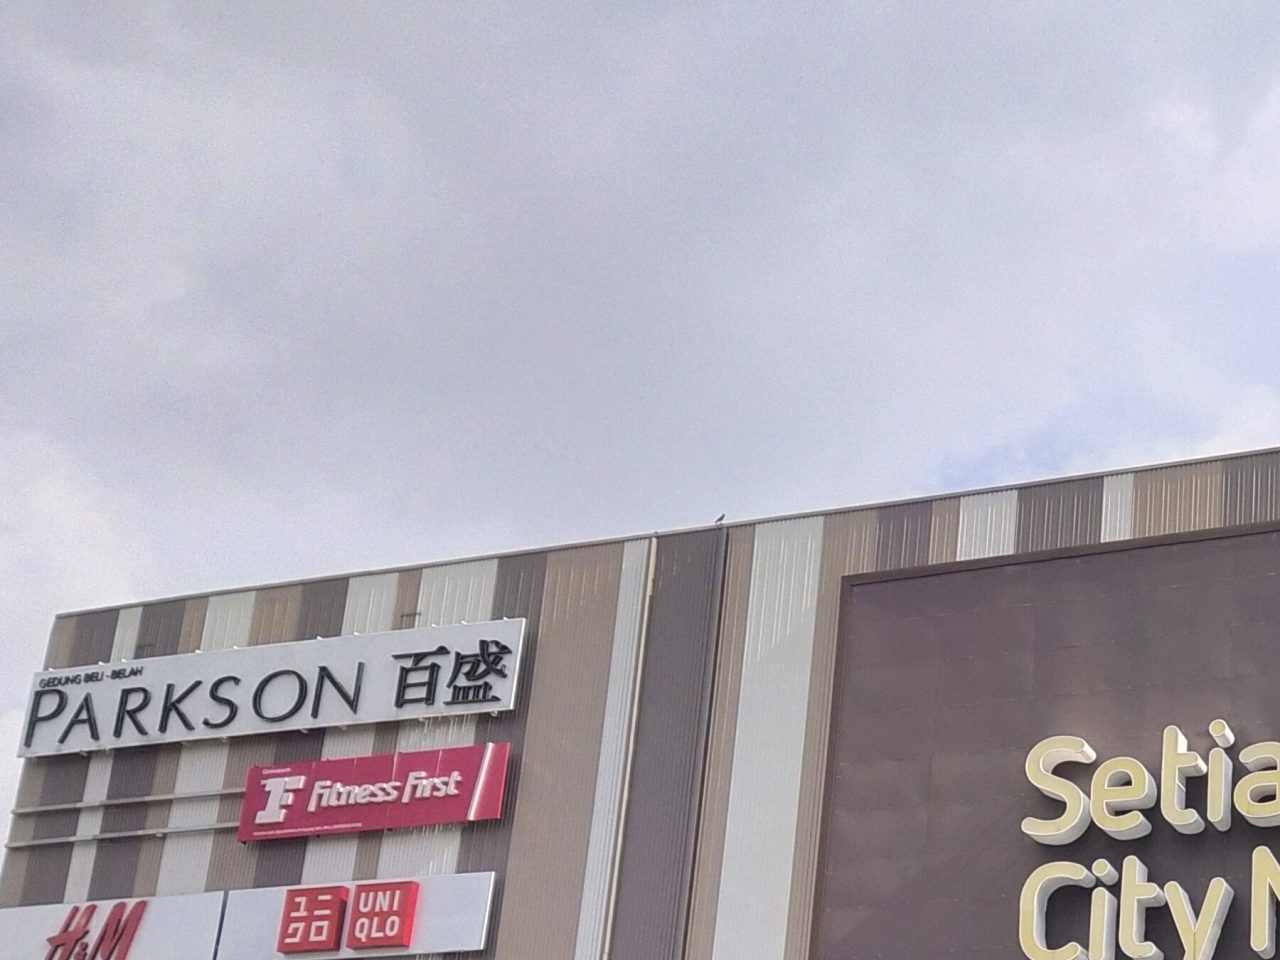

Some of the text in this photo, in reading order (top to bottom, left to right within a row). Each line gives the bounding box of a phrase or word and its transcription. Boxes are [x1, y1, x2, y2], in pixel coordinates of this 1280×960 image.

[39, 673, 82, 688] GEDUNG
[391, 638, 513, 709] 百盛
[23, 661, 365, 747] PARKSON
[307, 770, 462, 813] Fitness First
[358, 890, 401, 913] UNI
[354, 915, 400, 942] QLO
